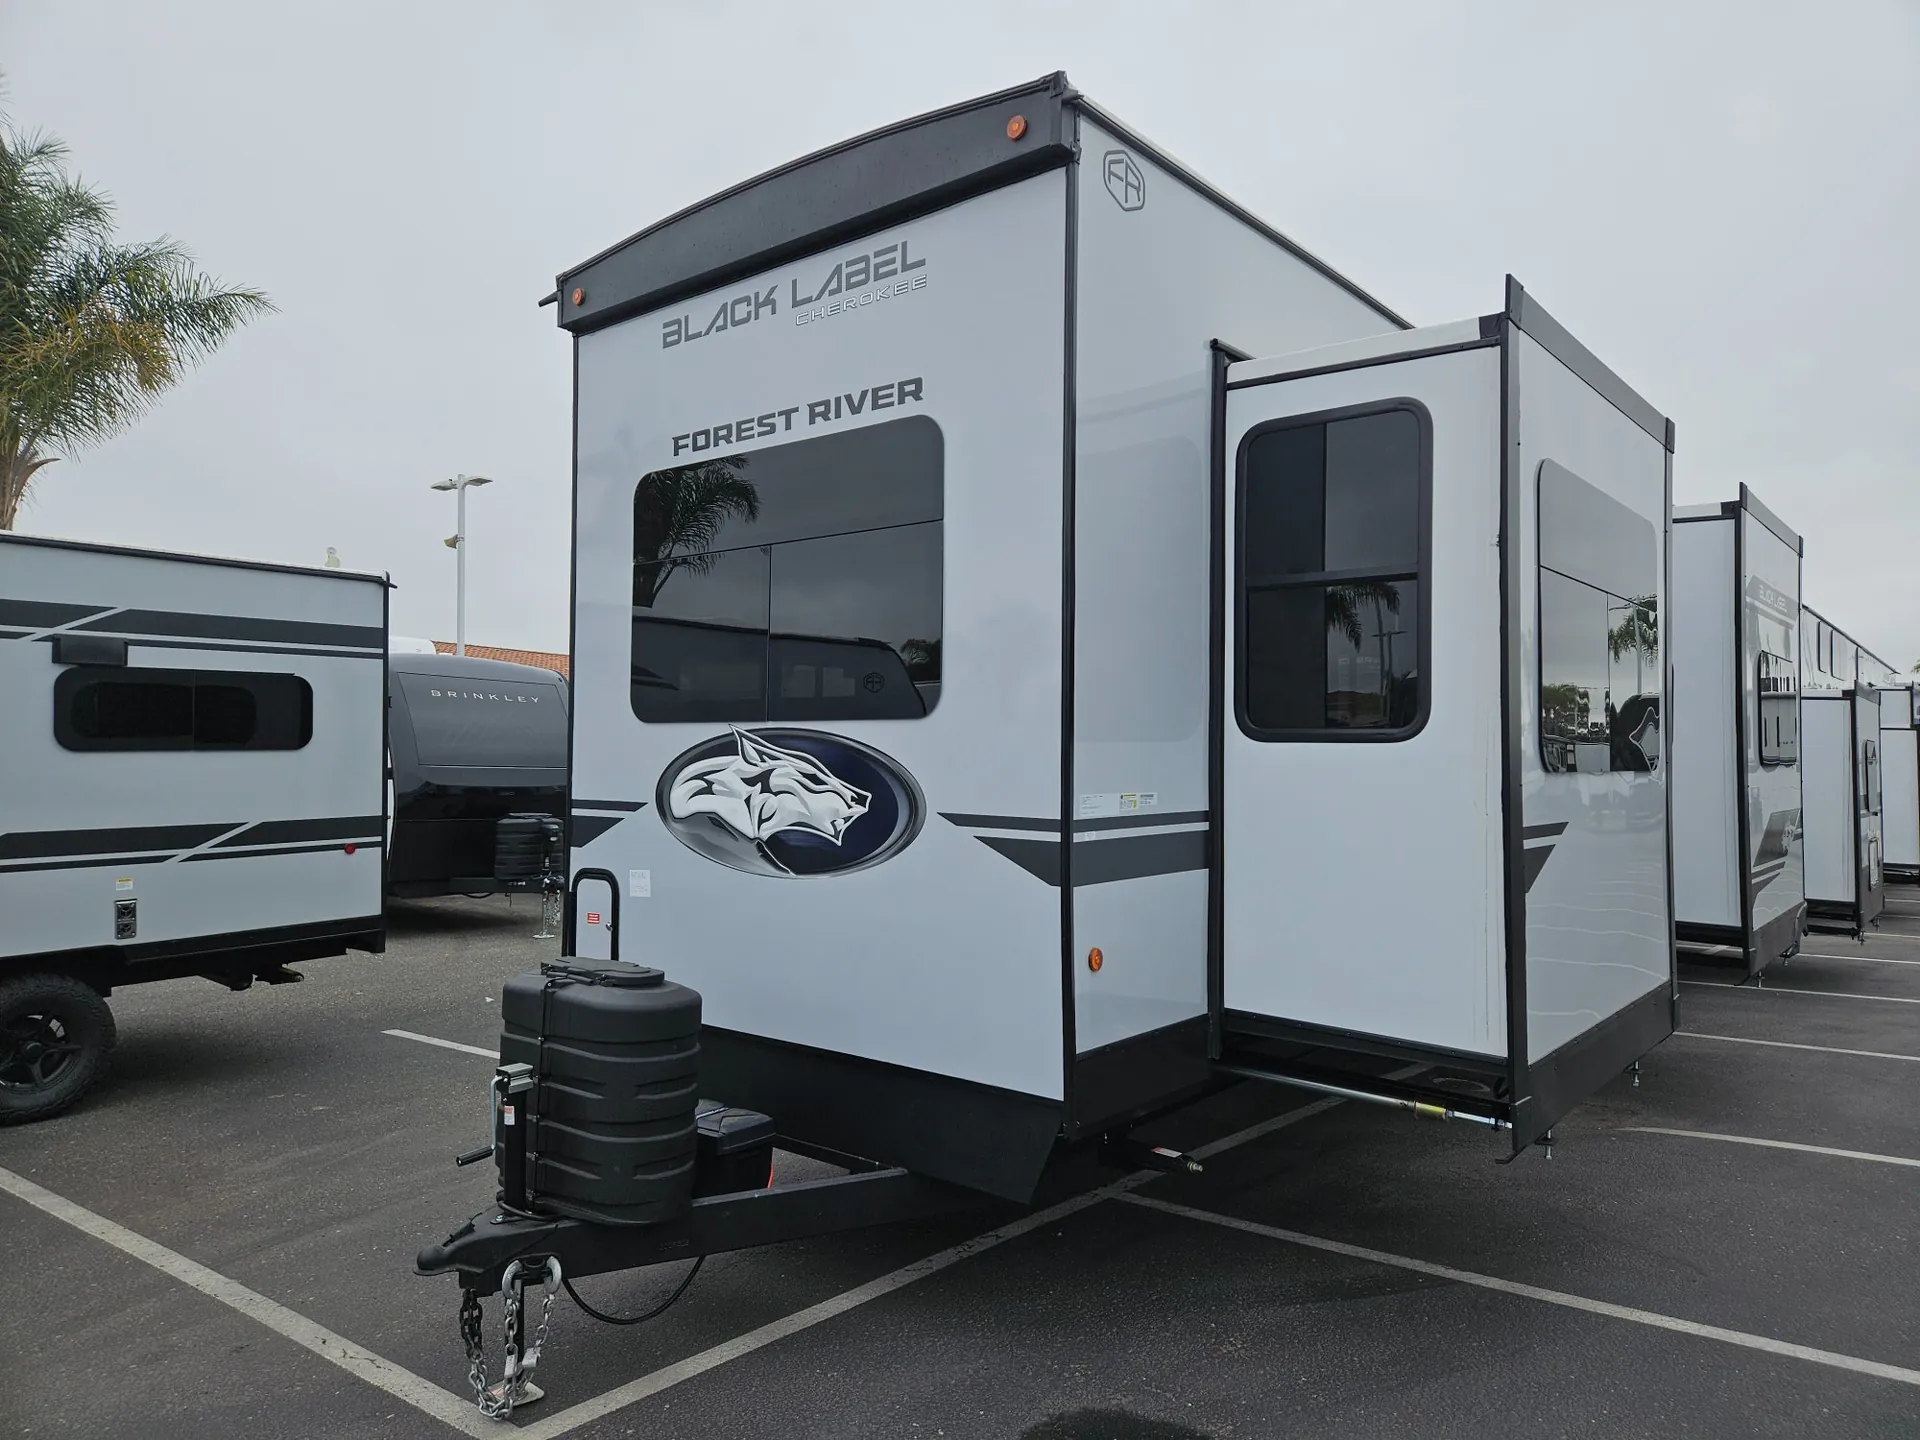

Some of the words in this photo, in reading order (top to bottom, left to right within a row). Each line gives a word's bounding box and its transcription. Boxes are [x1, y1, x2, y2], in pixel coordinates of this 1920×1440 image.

[662, 285, 778, 349] BLACK
[792, 241, 926, 308] LABEL
[796, 274, 927, 326] CHEROKEE
[672, 407, 799, 456] FOREST
[807, 377, 923, 425] RIVER
[430, 689, 539, 703] BRINKLEY
